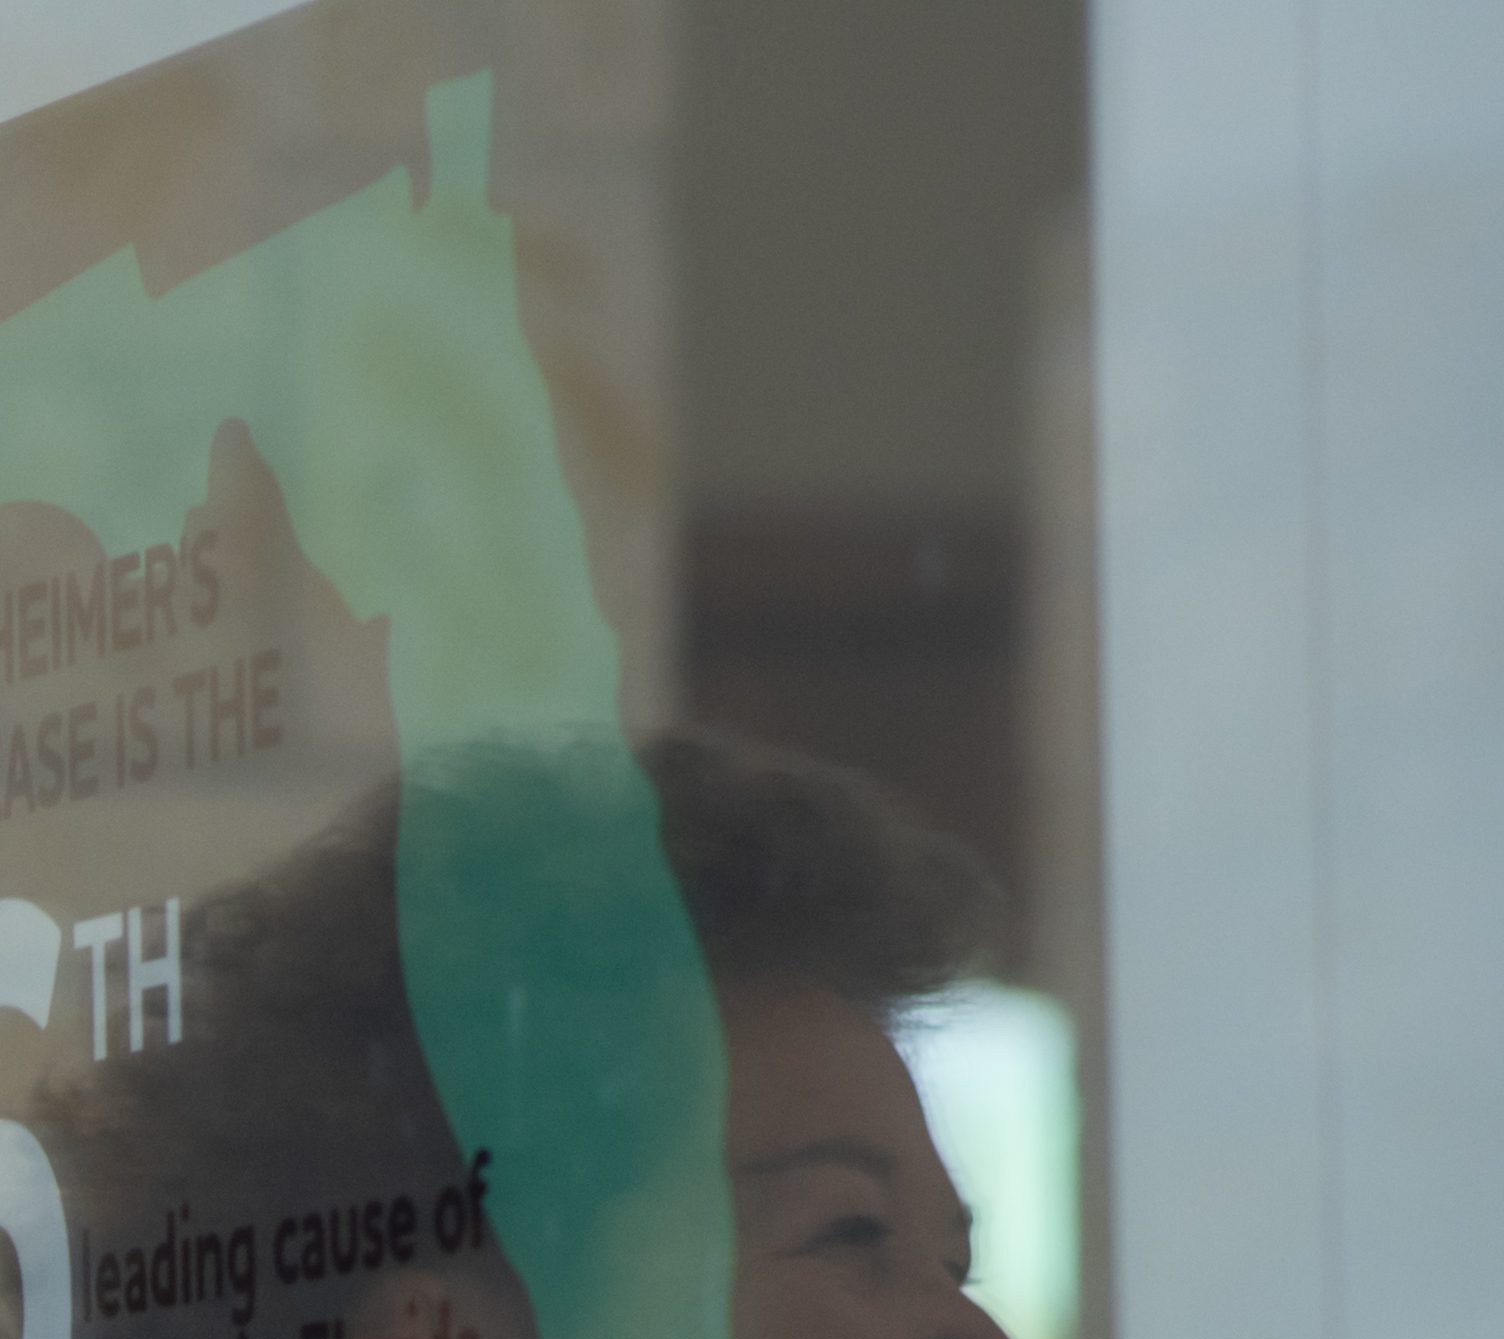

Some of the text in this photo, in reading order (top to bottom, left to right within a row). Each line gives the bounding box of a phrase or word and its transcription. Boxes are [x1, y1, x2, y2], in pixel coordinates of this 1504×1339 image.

[115, 687, 160, 790] IS
[172, 648, 284, 770] THE
[82, 1146, 492, 1326] leading cause of
